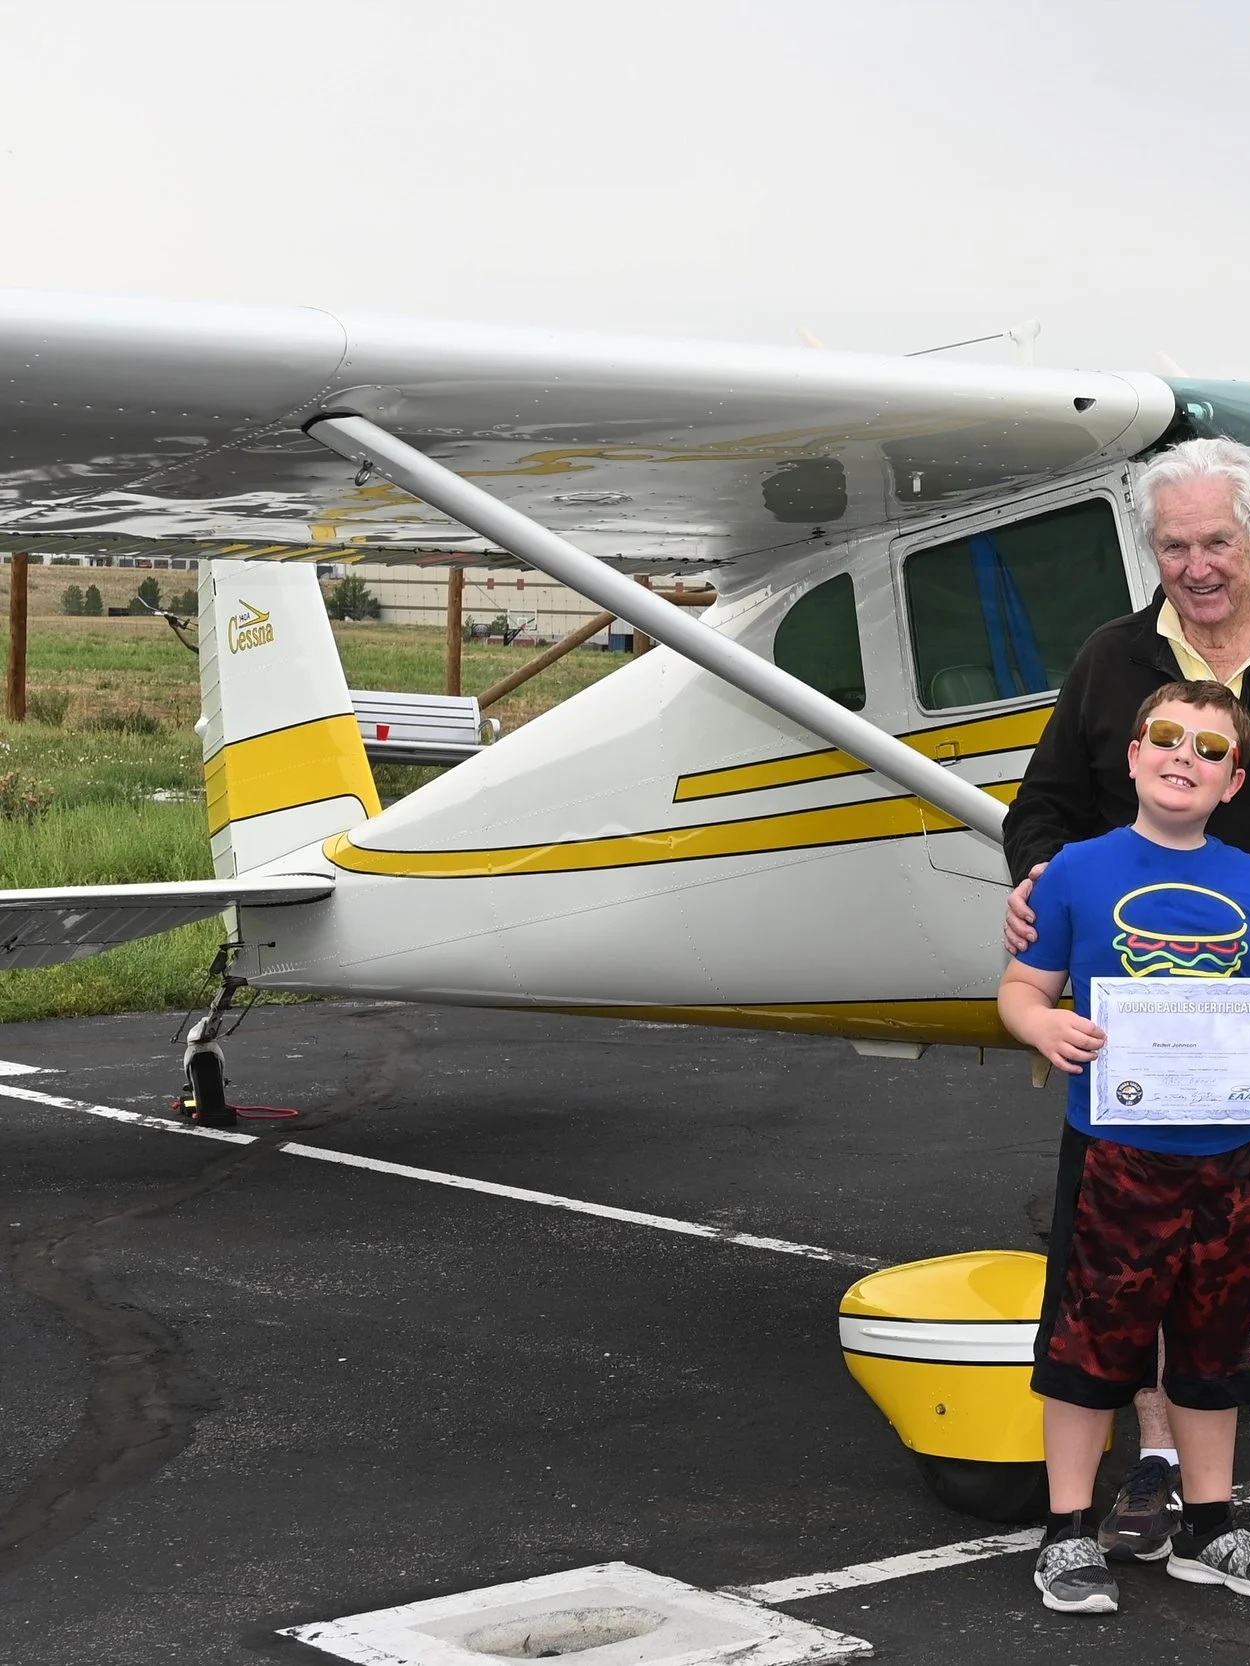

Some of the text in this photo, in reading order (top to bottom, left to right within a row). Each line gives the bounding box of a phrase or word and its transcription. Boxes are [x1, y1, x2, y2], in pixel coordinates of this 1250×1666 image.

[228, 615, 274, 654] Cessna
[1118, 1001, 1155, 1014] YOUNG
[1157, 1001, 1196, 1014] EAGLES
